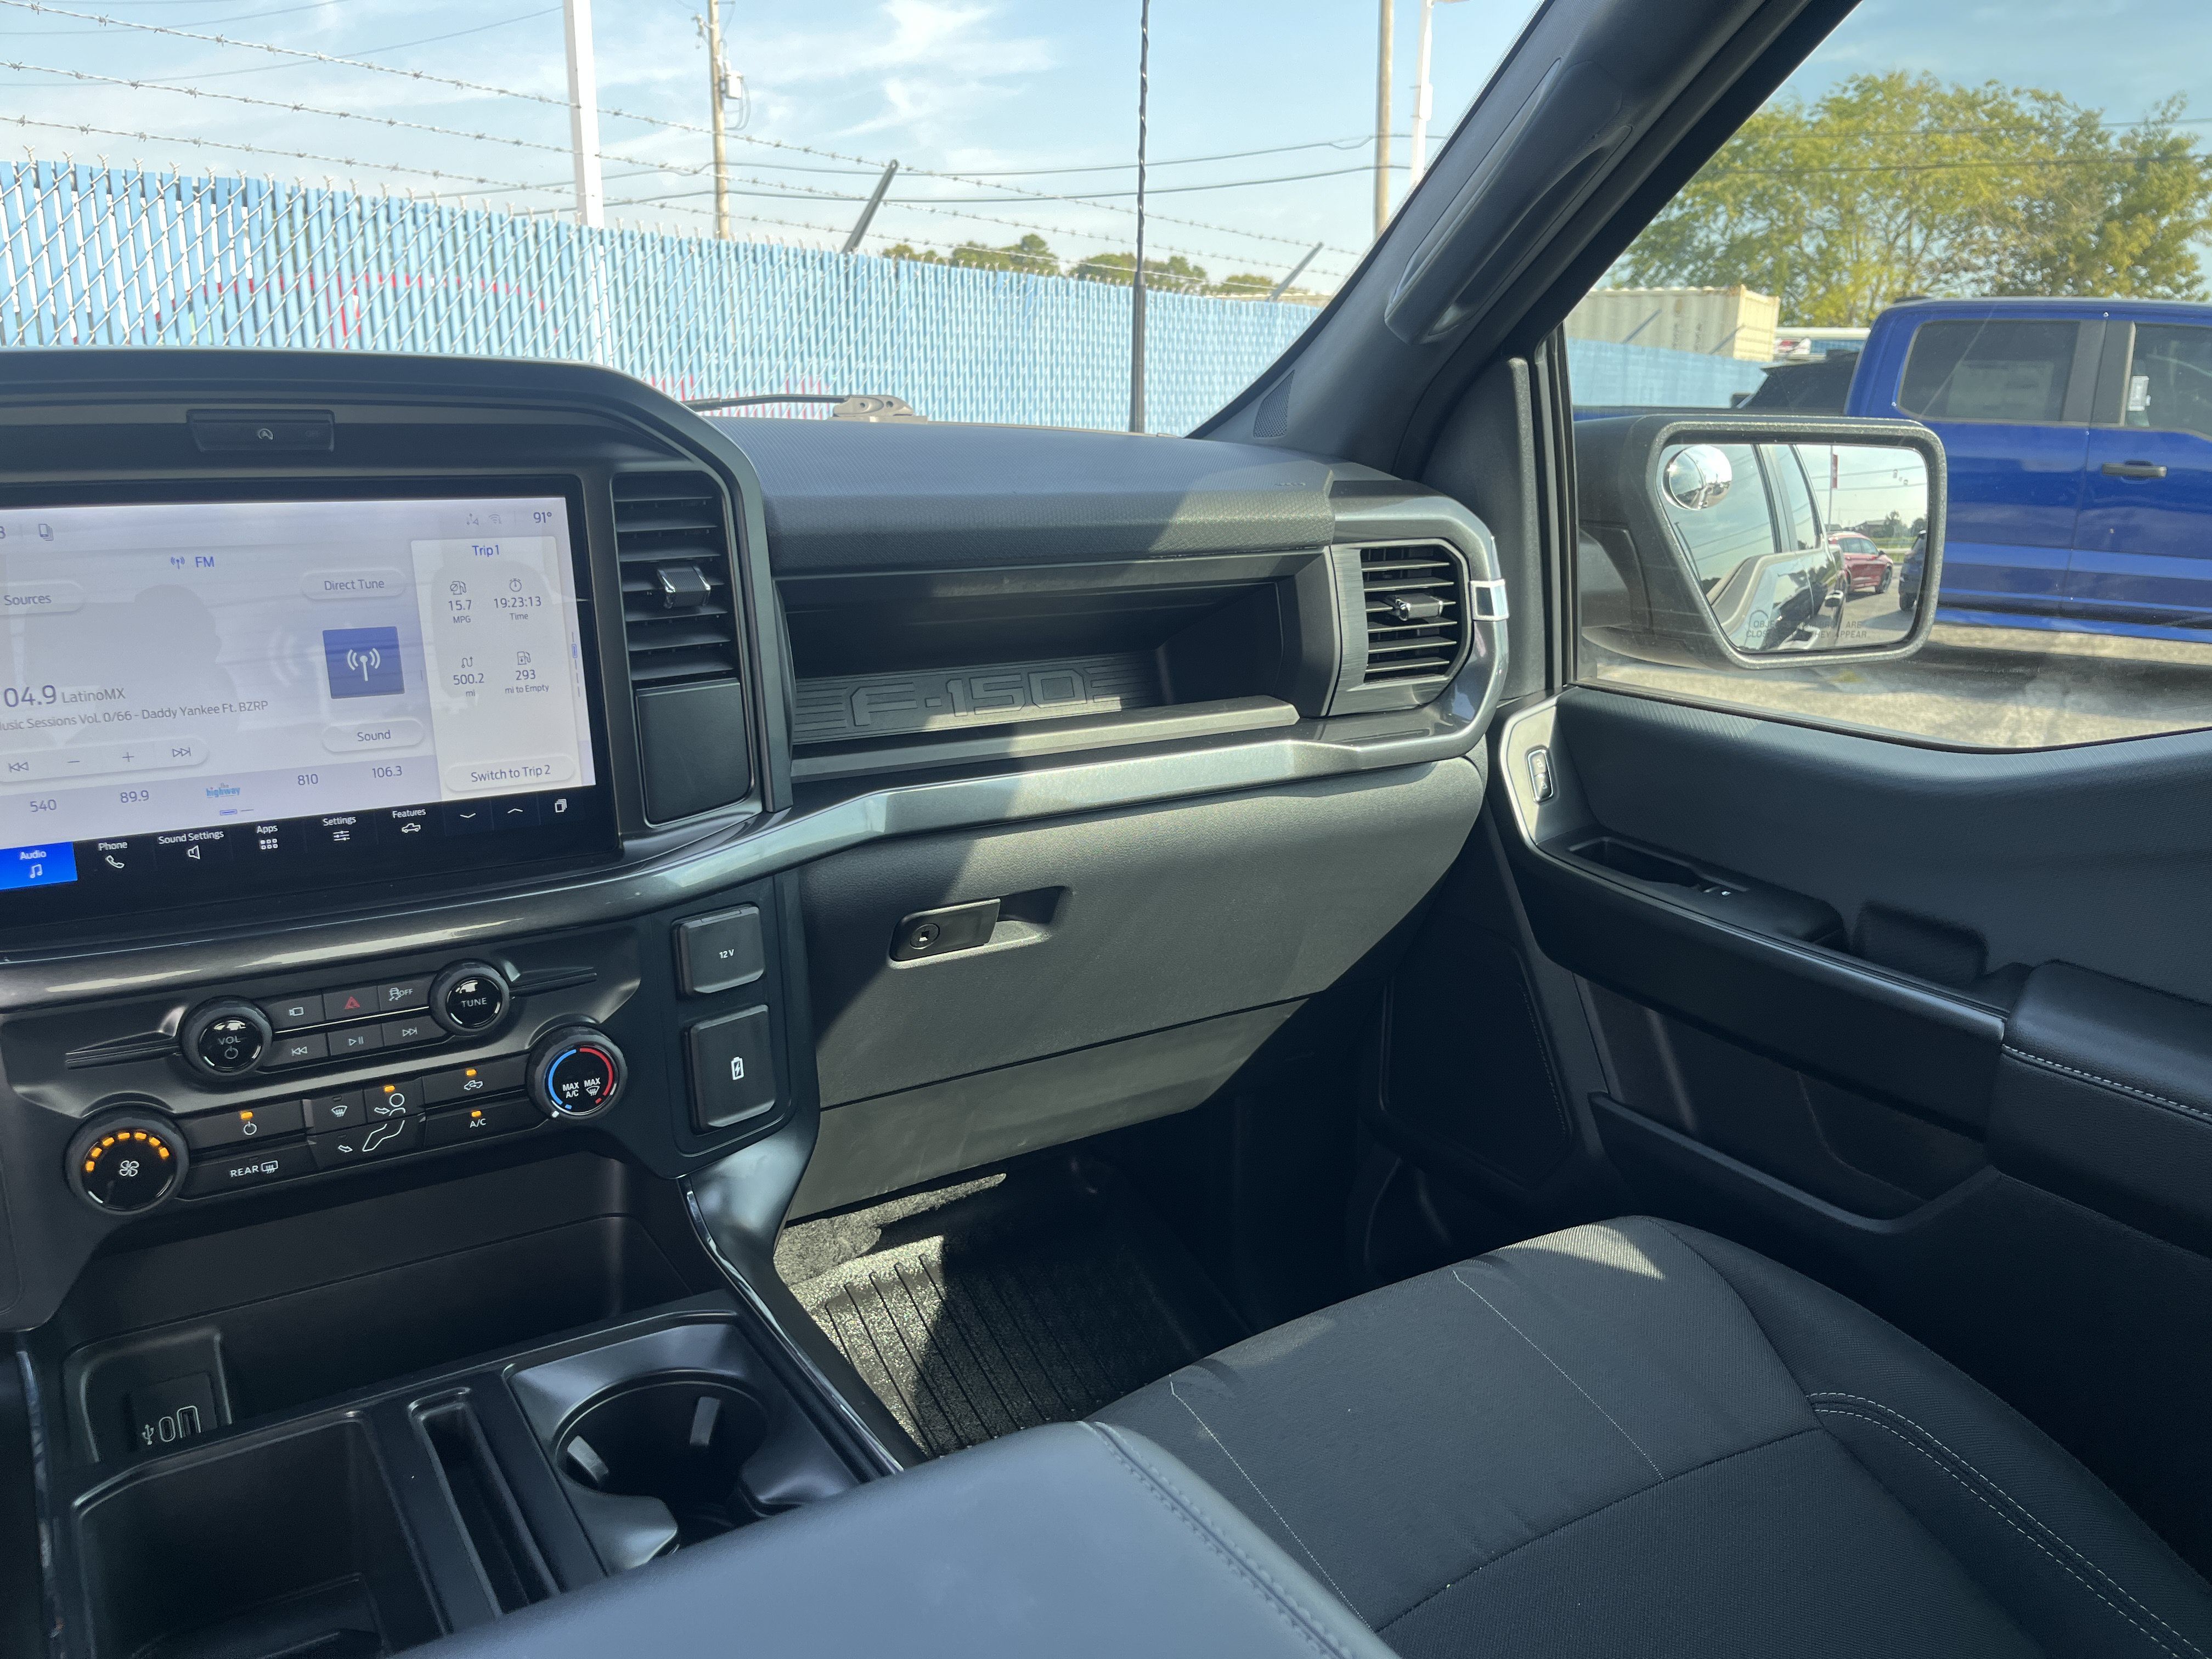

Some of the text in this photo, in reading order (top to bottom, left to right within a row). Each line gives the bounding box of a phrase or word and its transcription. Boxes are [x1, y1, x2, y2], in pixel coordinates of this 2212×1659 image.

[472, 545, 493, 557] Trip
[195, 556, 215, 567] FM
[324, 578, 385, 591] Direct Tune
[3, 593, 52, 606] Sources
[448, 599, 472, 612] 15.7
[493, 596, 542, 609] 19:23:13
[453, 614, 471, 624] MPG
[509, 612, 529, 621] Time
[1846, 620, 1862, 629] ARE
[453, 672, 485, 685] 500.2
[515, 669, 536, 681] 293
[465, 689, 476, 697] mi
[505, 683, 549, 695] mi to Empty
[3, 685, 126, 708] 04.9 LatinoMX
[850, 668, 1087, 727] F-150
[27, 716, 77, 729] Sessions
[103, 710, 132, 723] 0/66
[142, 707, 177, 720] Daddy
[179, 704, 220, 717] Yankee
[222, 703, 237, 714] Ft.
[239, 700, 268, 712] BZRP
[357, 729, 391, 742] Sound
[371, 765, 403, 779] 106.3
[471, 764, 551, 783] Switch to Trip 2
[297, 774, 319, 786] 810
[120, 790, 150, 804] 89.9
[206, 787, 240, 798] highway
[29, 799, 57, 813] 540
[392, 808, 426, 819] Features
[323, 815, 357, 827] Settings
[256, 824, 278, 834] Apps
[158, 830, 224, 845] Sound Settings
[98, 840, 128, 851] Phone
[19, 850, 47, 861] Audio
[399, 988, 413, 996] OFF
[461, 997, 487, 1008] TUNE
[218, 1036, 241, 1045] VOL
[562, 1081, 579, 1092] MAX
[584, 1077, 601, 1088] MAX
[566, 1090, 579, 1098] A/C
[469, 1118, 487, 1129] A/C
[230, 1165, 259, 1178] REAR
